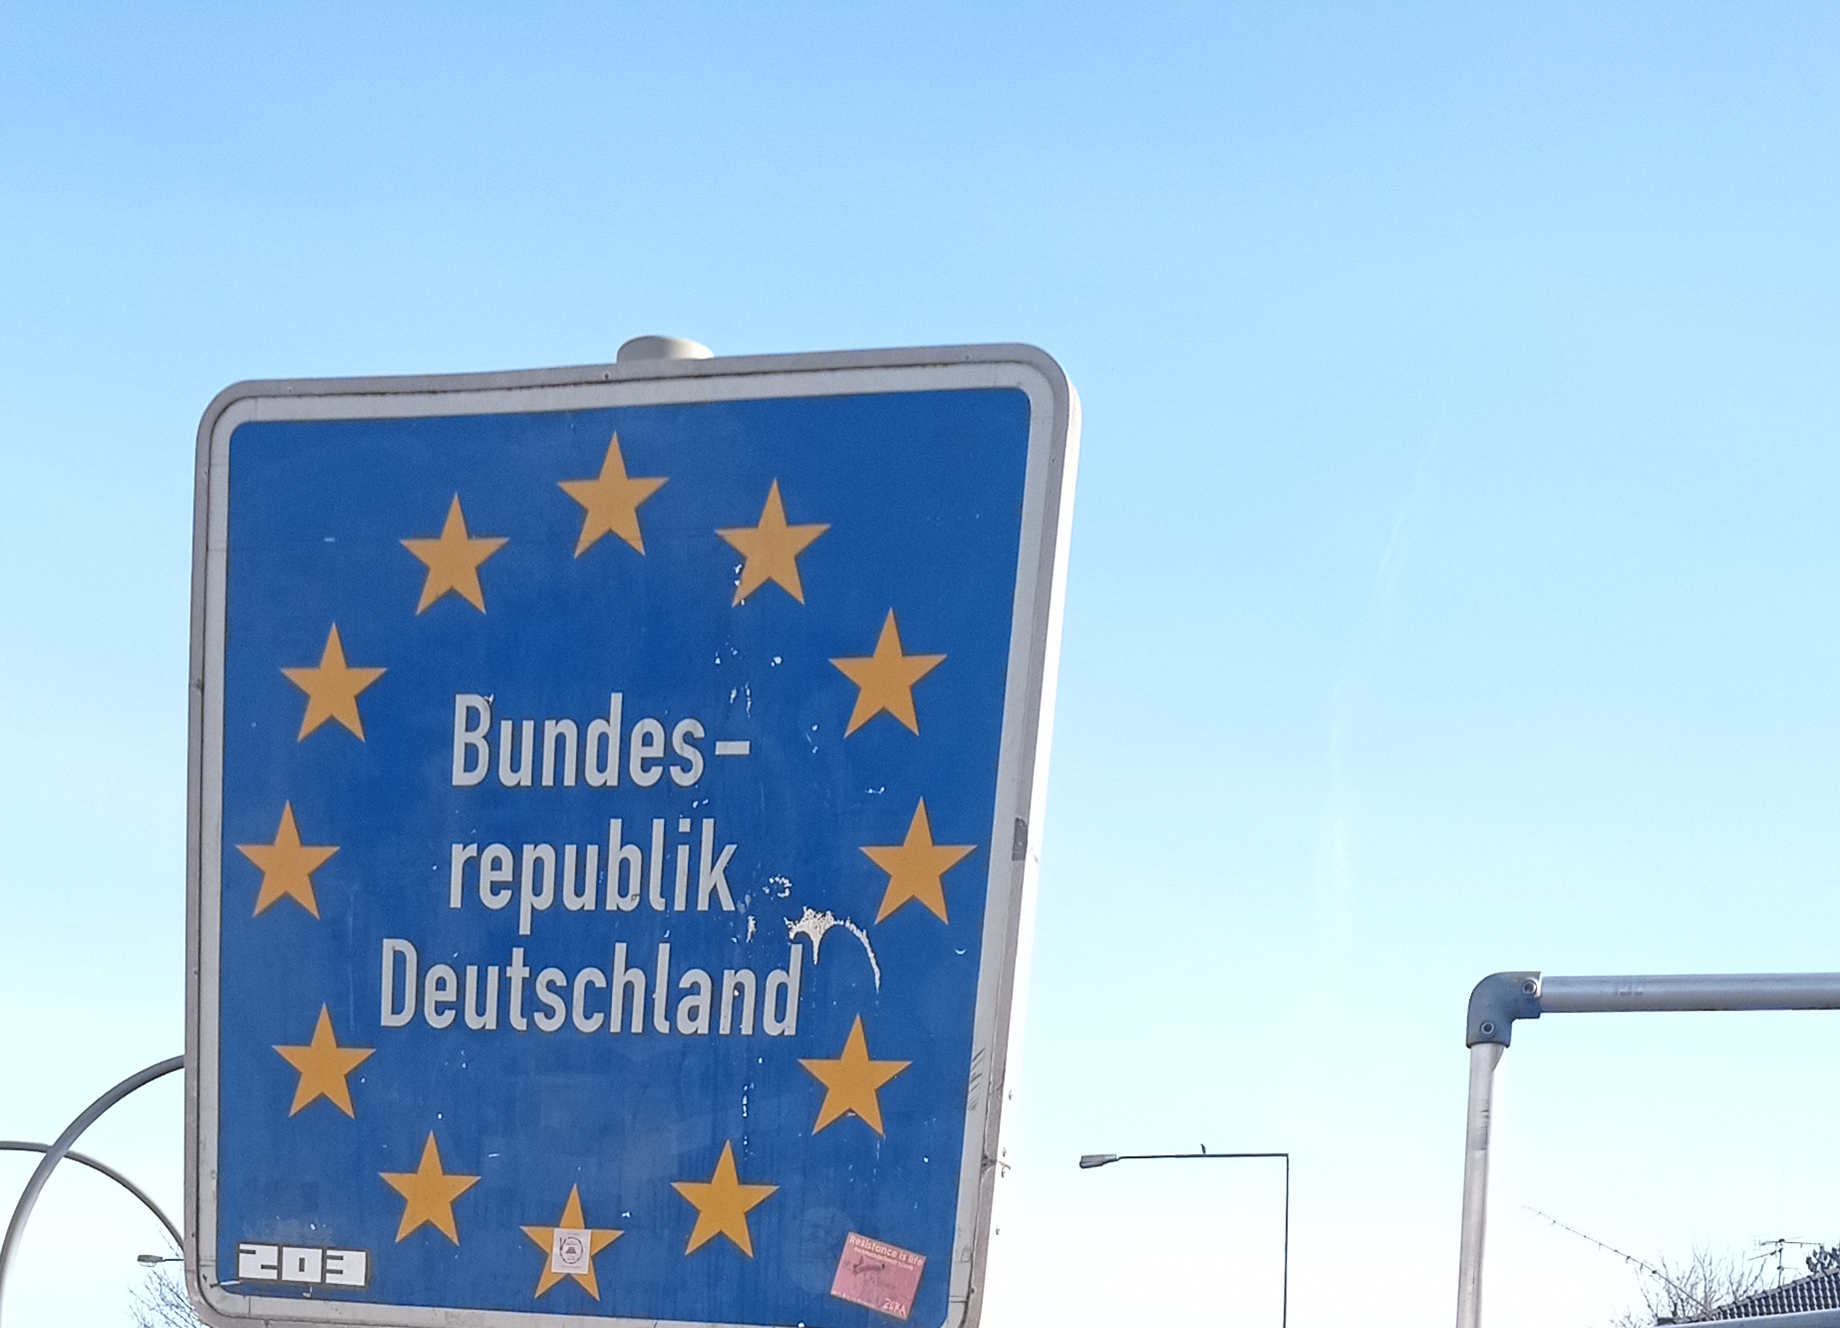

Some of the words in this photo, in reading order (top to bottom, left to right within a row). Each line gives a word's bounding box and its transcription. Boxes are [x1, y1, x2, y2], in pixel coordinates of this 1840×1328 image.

[452, 692, 750, 788] Bundes-
[449, 818, 738, 936] republik
[380, 937, 803, 1037] Deutschland
[238, 1243, 367, 1287] 203
[849, 1235, 898, 1258] Resistance
[898, 1251, 907, 1261] is
[908, 1253, 925, 1267] life
